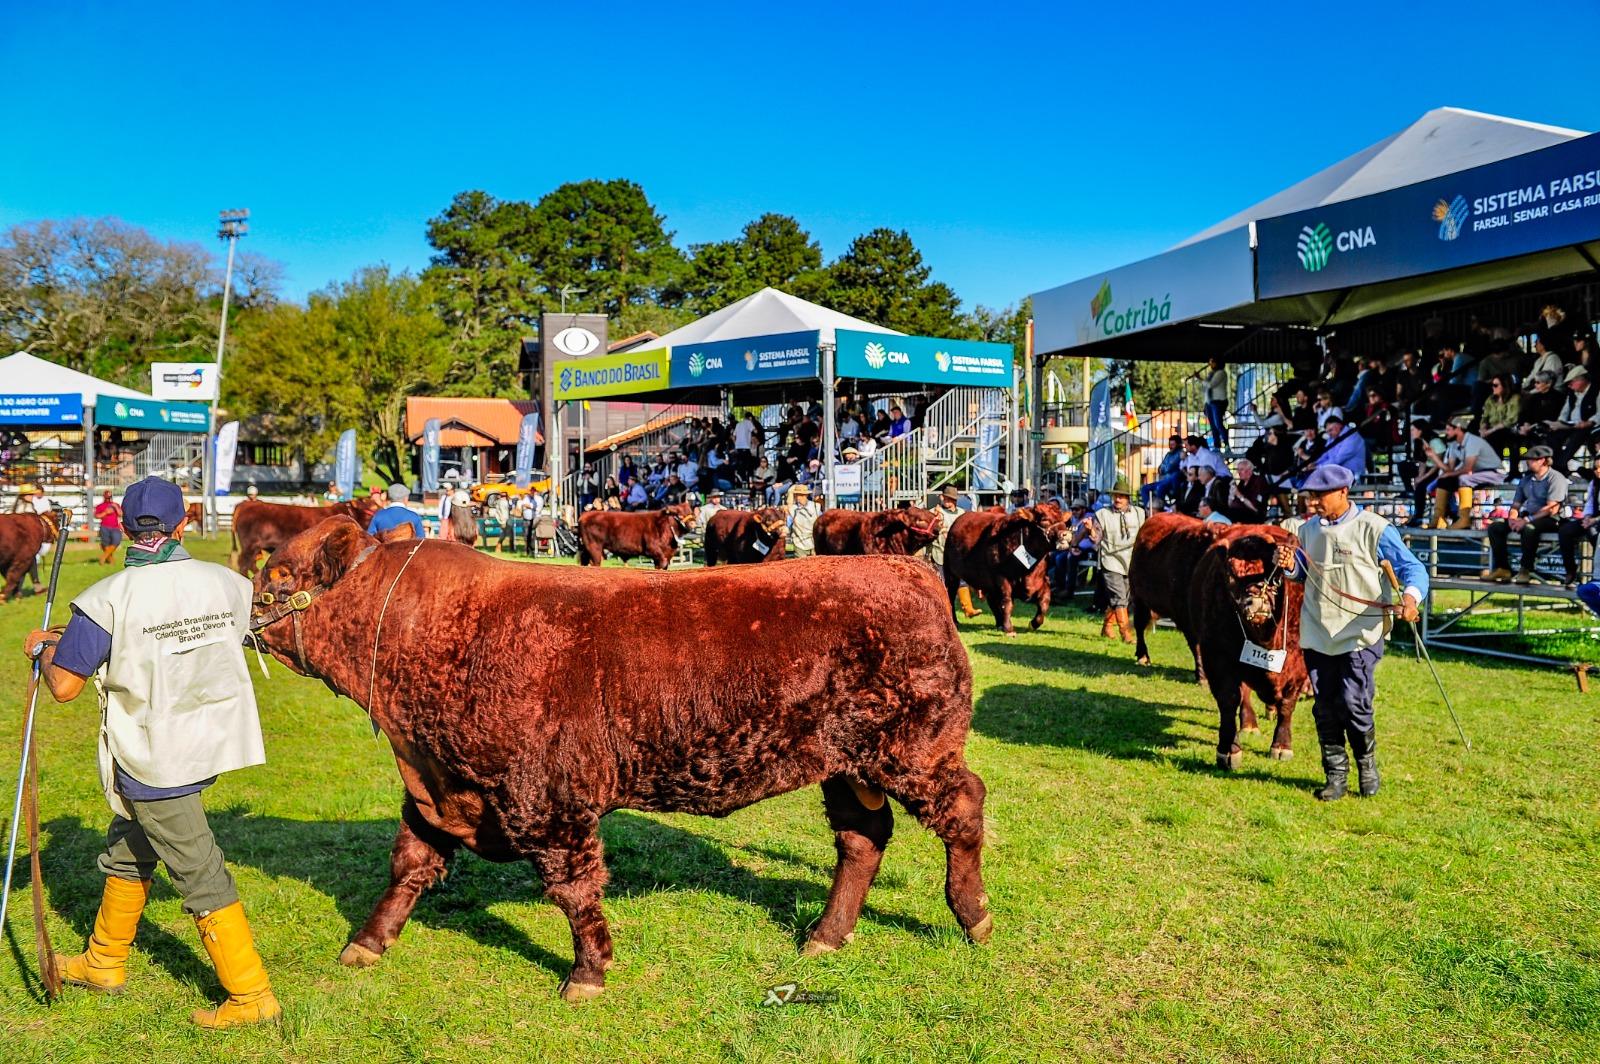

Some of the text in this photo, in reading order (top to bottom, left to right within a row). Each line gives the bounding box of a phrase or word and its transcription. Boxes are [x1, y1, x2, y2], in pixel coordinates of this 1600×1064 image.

[1473, 183, 1546, 216] SISTEMA
[1473, 193, 1600, 232] FARSUL SENAR CASA RU
[1336, 226, 1377, 252] CNA
[1103, 292, 1172, 336] Cotribá
[705, 357, 723, 370] CNA
[759, 347, 810, 361] SISTEMA FARSUL
[887, 351, 910, 365] CNA
[575, 361, 660, 388] BANCO DO BRASIL
[142, 611, 233, 635] Associação Brasileira dos
[155, 628, 189, 641] Criadores
[190, 625, 201, 633] de
[202, 621, 226, 631] Devon
[178, 632, 206, 643] Bravon
[1252, 649, 1275, 662] 1145
